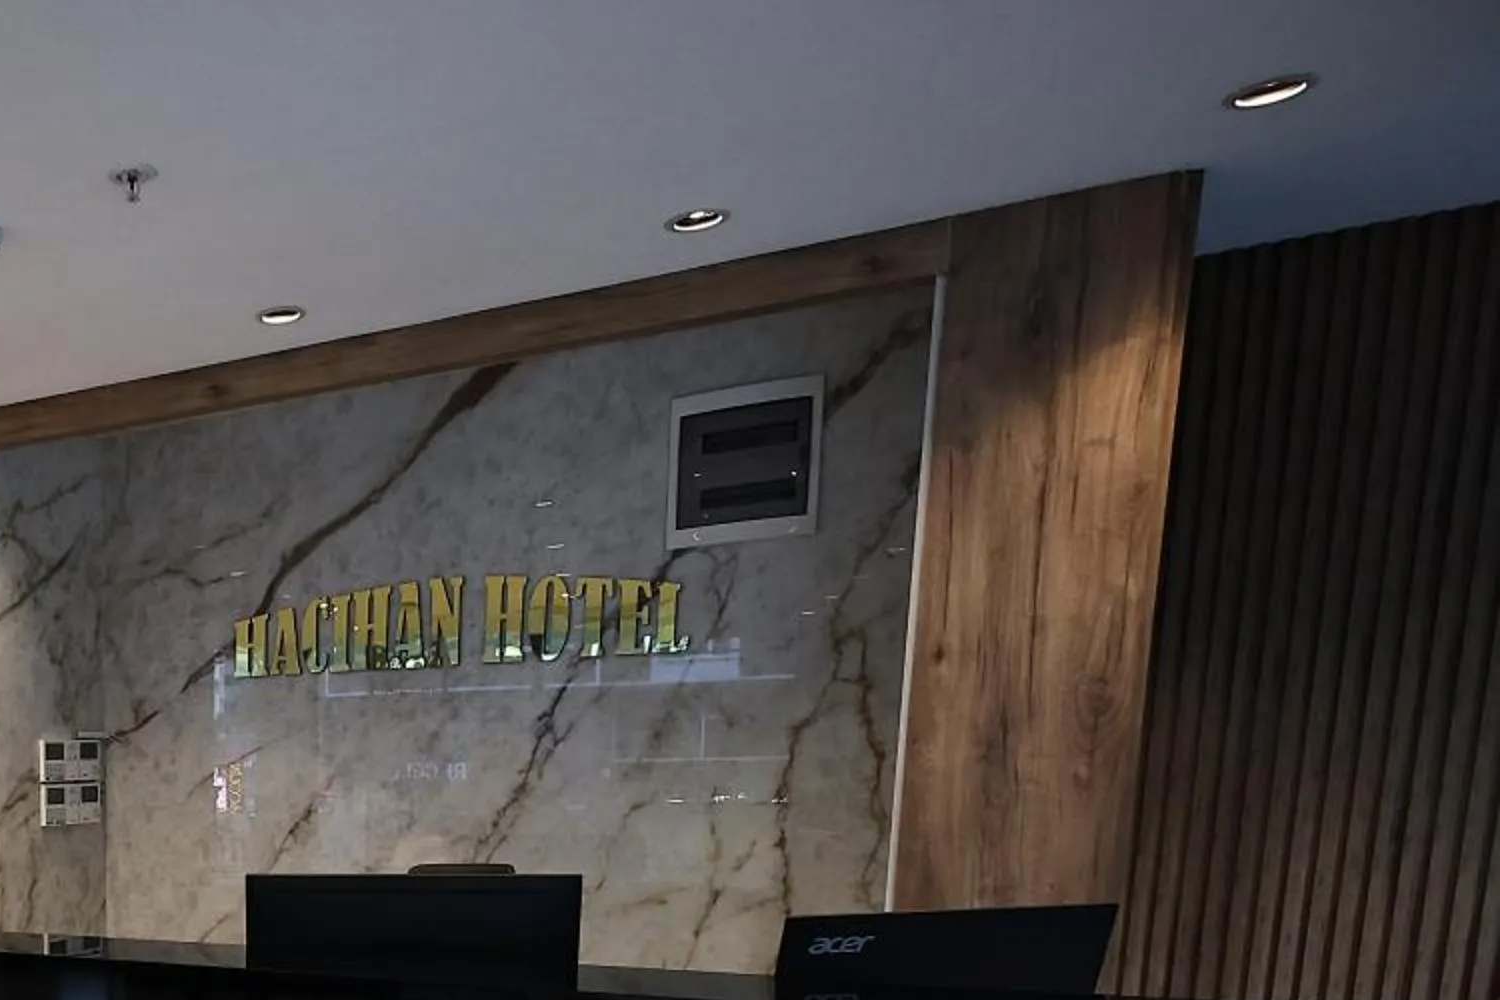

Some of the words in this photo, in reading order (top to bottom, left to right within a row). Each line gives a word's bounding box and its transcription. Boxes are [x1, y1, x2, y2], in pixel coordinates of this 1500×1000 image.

[233, 574, 465, 679] HACIHAN
[483, 573, 692, 664] HOTEL
[807, 934, 876, 955] acer
